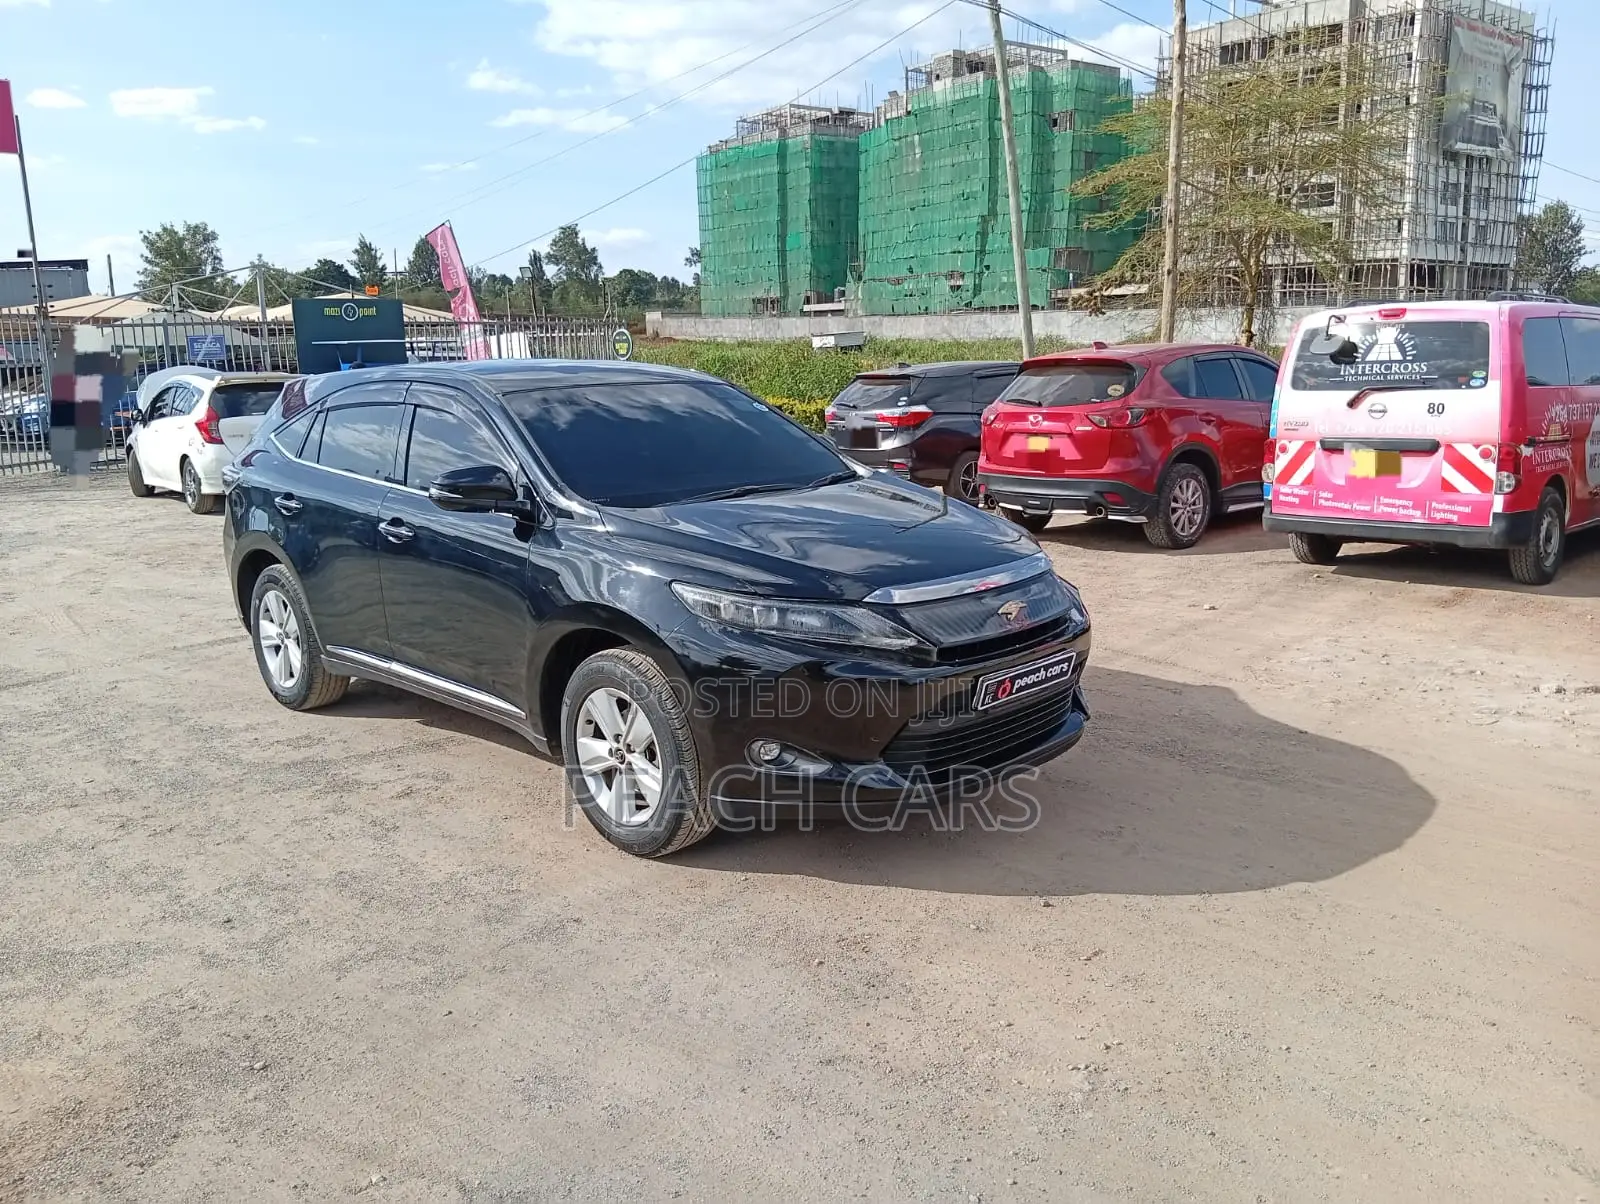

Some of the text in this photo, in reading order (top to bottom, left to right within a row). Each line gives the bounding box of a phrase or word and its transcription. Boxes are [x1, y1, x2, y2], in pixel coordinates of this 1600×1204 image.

[359, 305, 377, 319] point
[1340, 362, 1428, 376] INTERCROSS
[1344, 373, 1421, 382] TECHNICAL SERVICES
[1427, 402, 1445, 415] 80
[1532, 444, 1573, 465] INTERCROSS
[1380, 496, 1414, 508] Emergency
[1432, 501, 1472, 513] Professional
[1431, 511, 1458, 522] Lighting
[1012, 661, 1069, 694] peach cars
